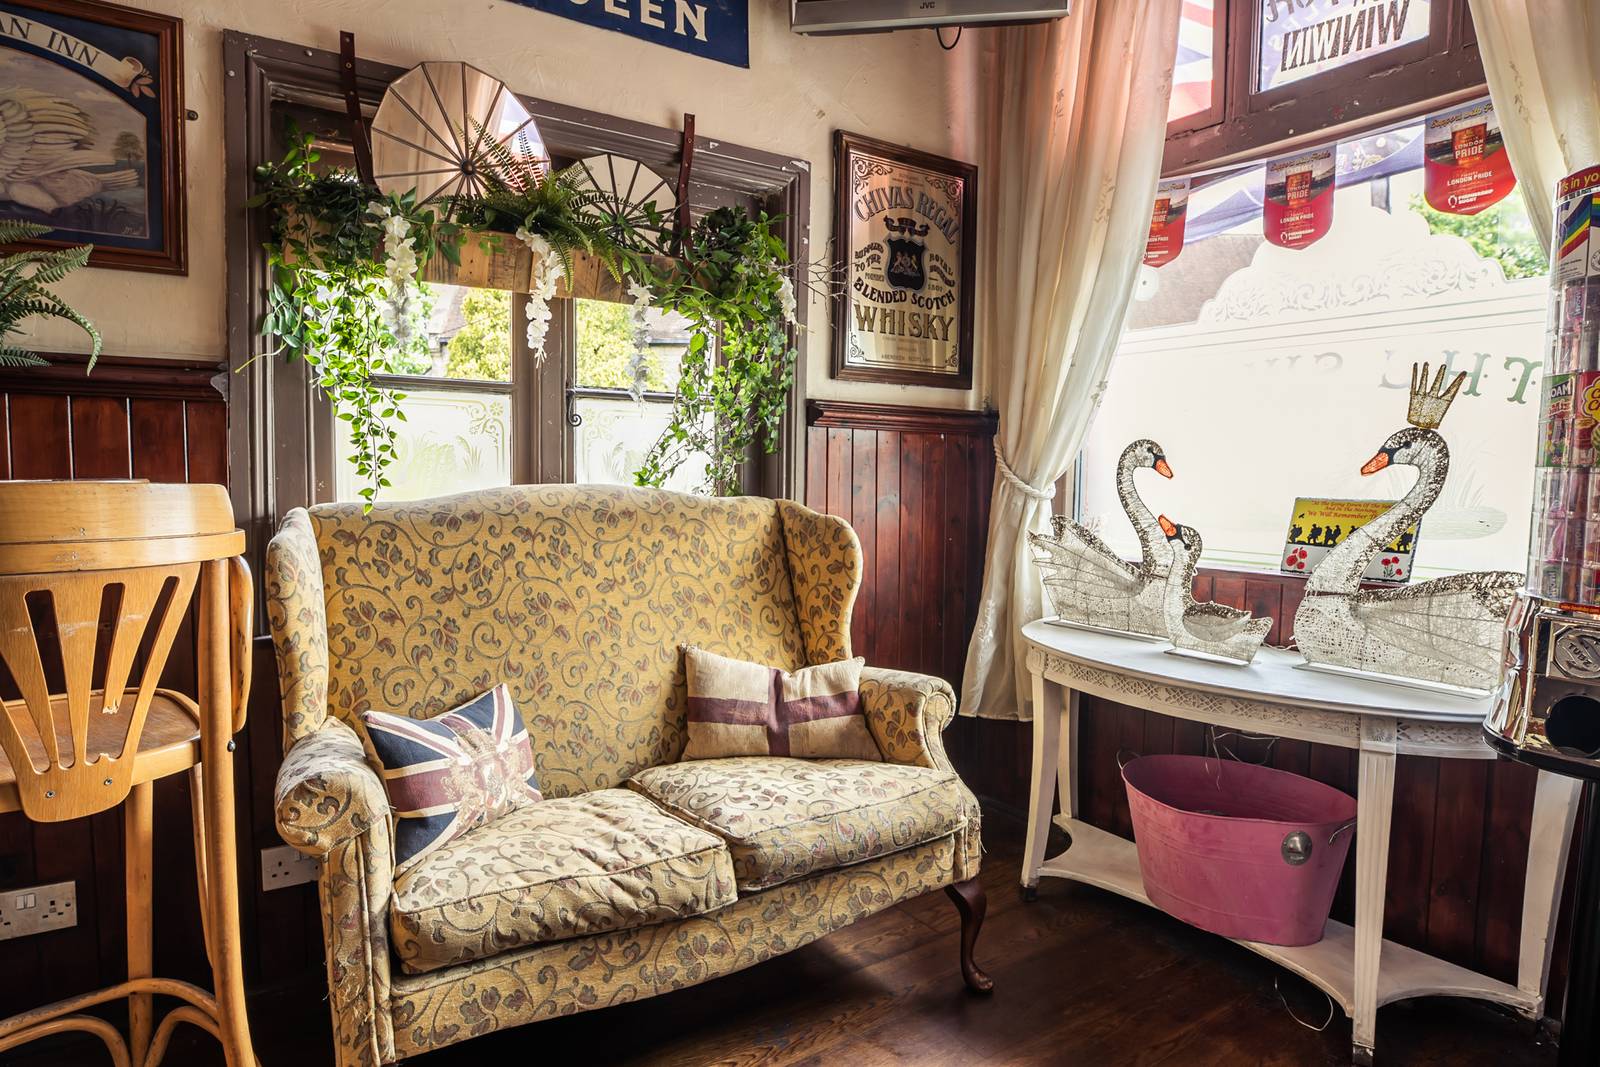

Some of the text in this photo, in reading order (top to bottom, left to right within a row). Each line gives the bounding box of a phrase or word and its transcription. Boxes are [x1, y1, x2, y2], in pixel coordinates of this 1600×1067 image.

[919, 1, 936, 9] JVC
[46, 31, 100, 67] INN
[1455, 145, 1484, 159] PRIDE
[1447, 175, 1473, 187] LONDON
[1473, 170, 1493, 180] PRIDE
[1570, 177, 1580, 189] in
[1287, 190, 1309, 201] PRIDE
[855, 186, 961, 245] CHIVAS REGAL
[854, 253, 882, 273] TO THE
[929, 253, 954, 277] ROYAL
[853, 275, 956, 311] BLENDED SCOTCH
[853, 304, 955, 341] WHISKY
[1568, 642, 1592, 668] TUBZ
